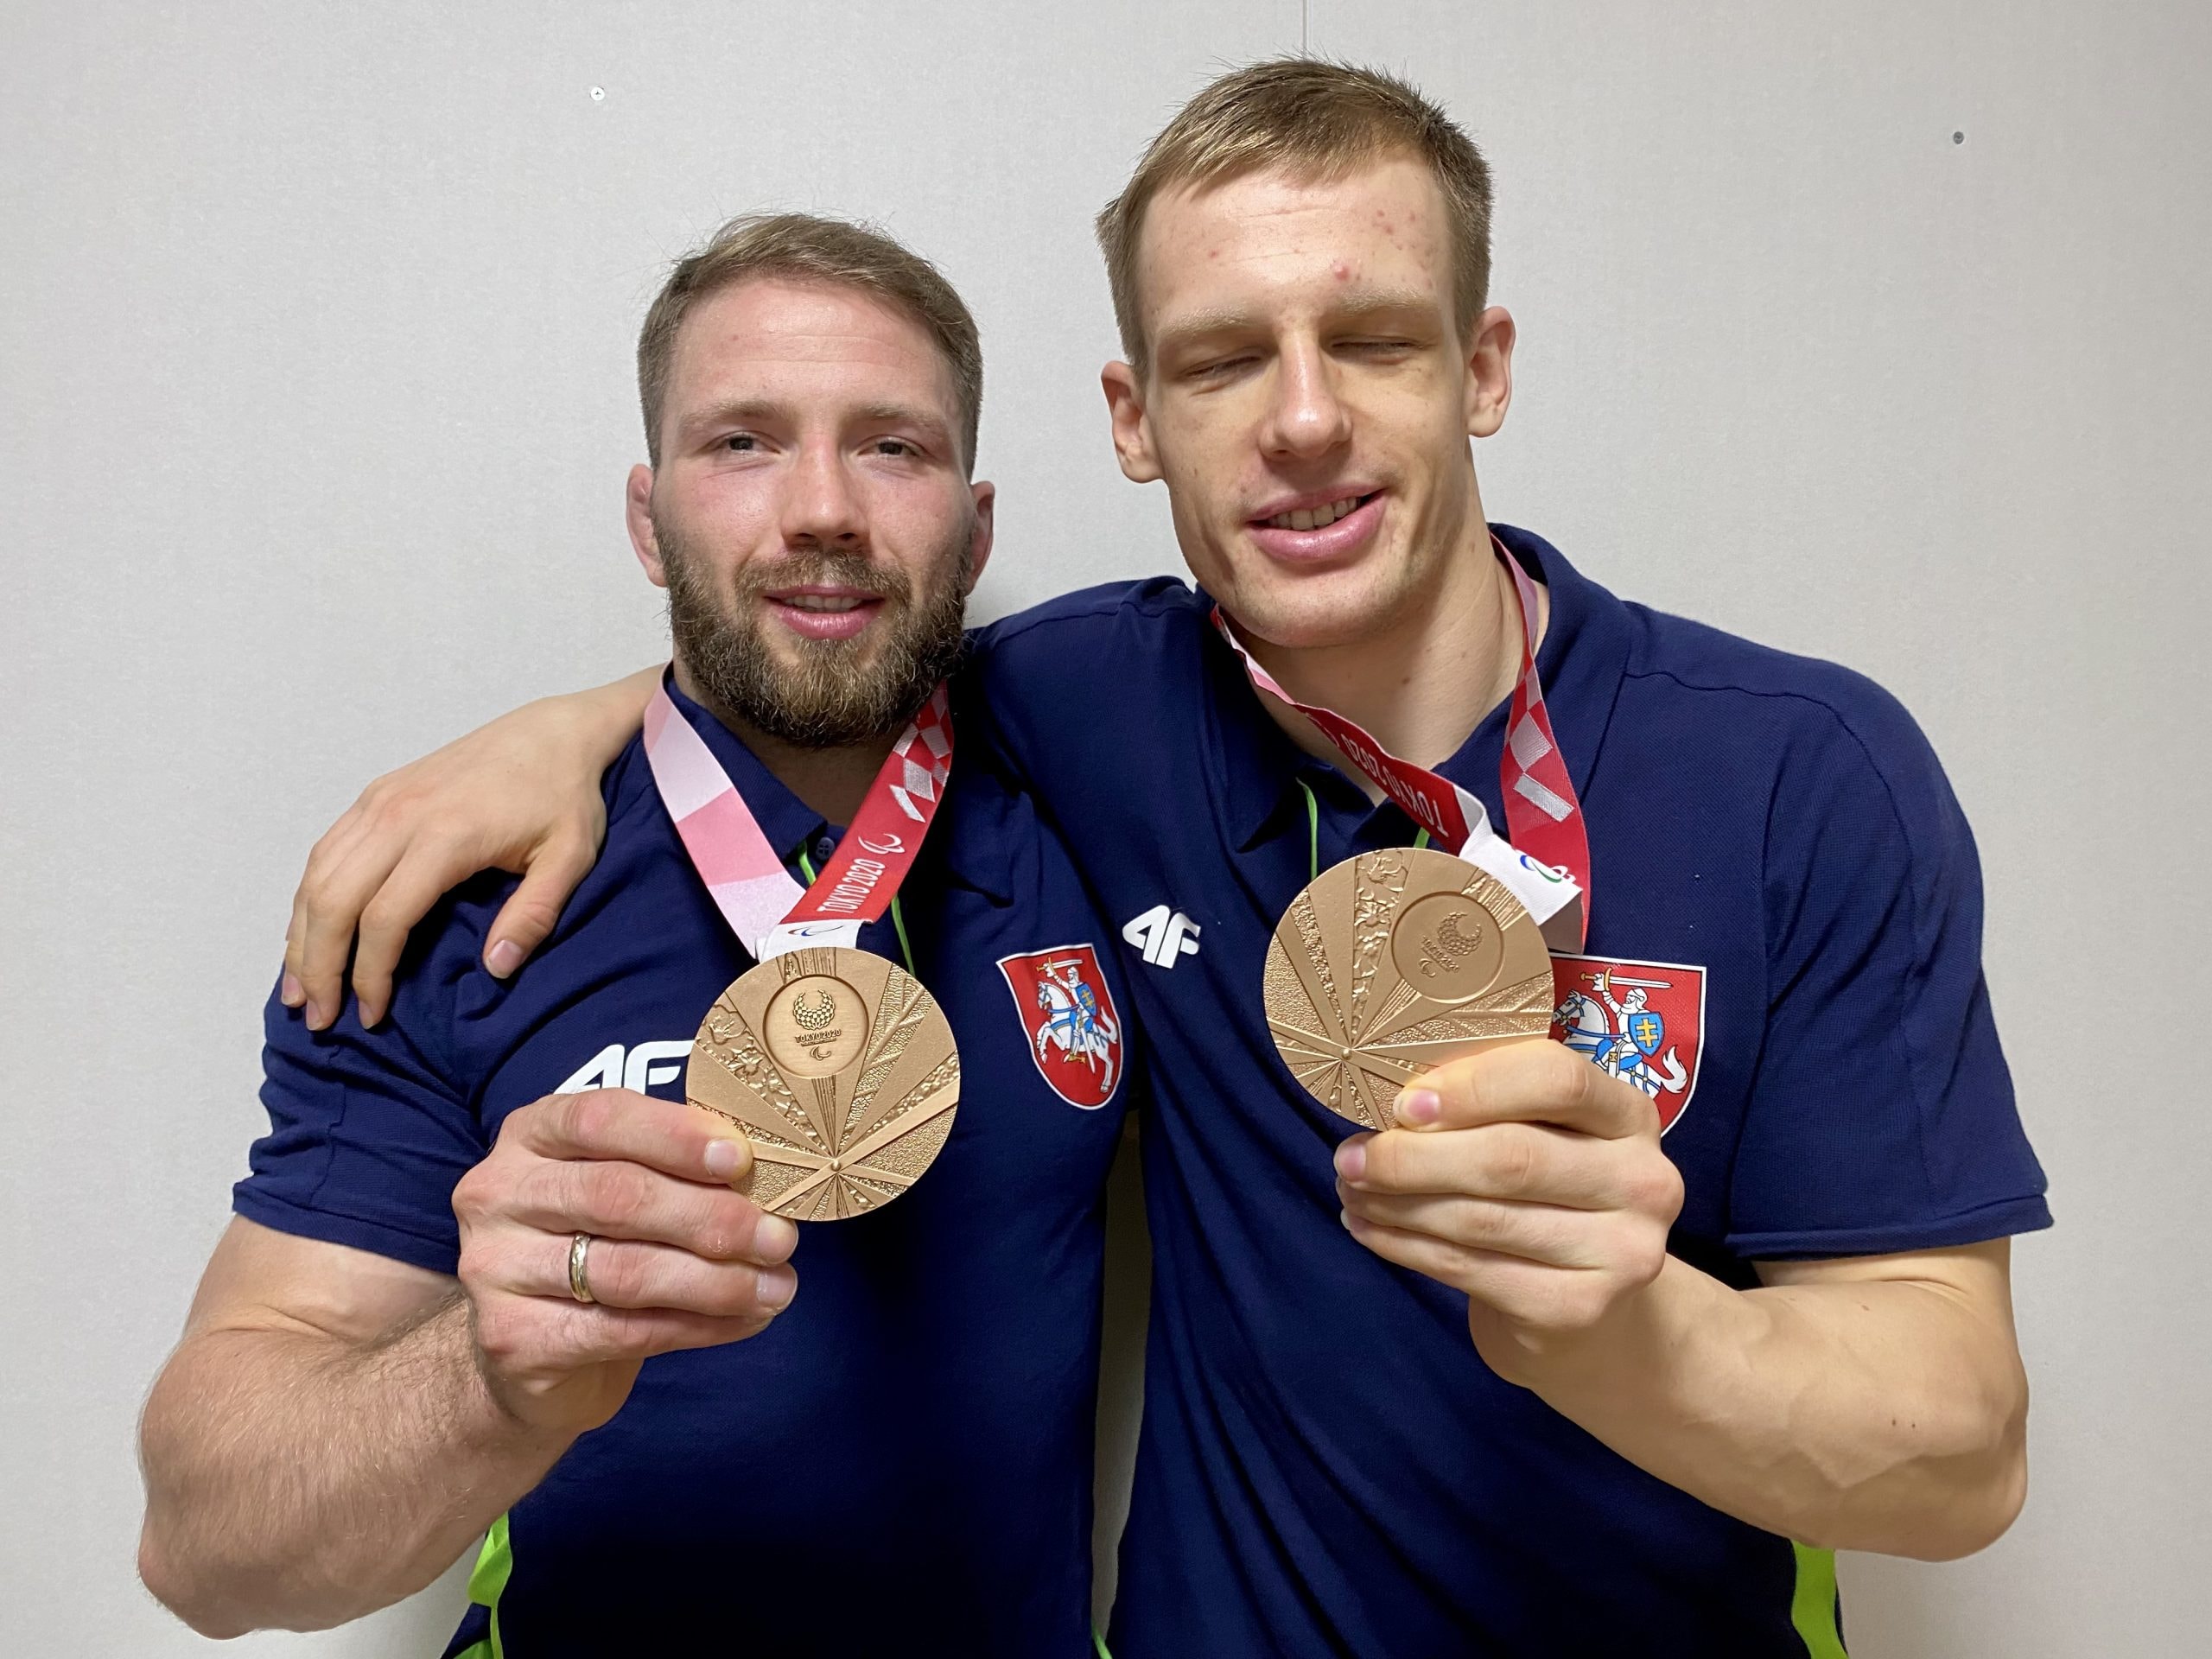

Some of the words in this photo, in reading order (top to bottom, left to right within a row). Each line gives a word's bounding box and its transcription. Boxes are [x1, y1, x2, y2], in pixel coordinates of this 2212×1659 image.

[1340, 734, 1387, 785] 2020
[1382, 766, 1449, 837] TOKYO
[842, 858, 886, 887] 2020
[816, 884, 871, 913] TOKYO
[795, 1032, 821, 1043] TOKYO
[822, 1028, 842, 1039] 2020
